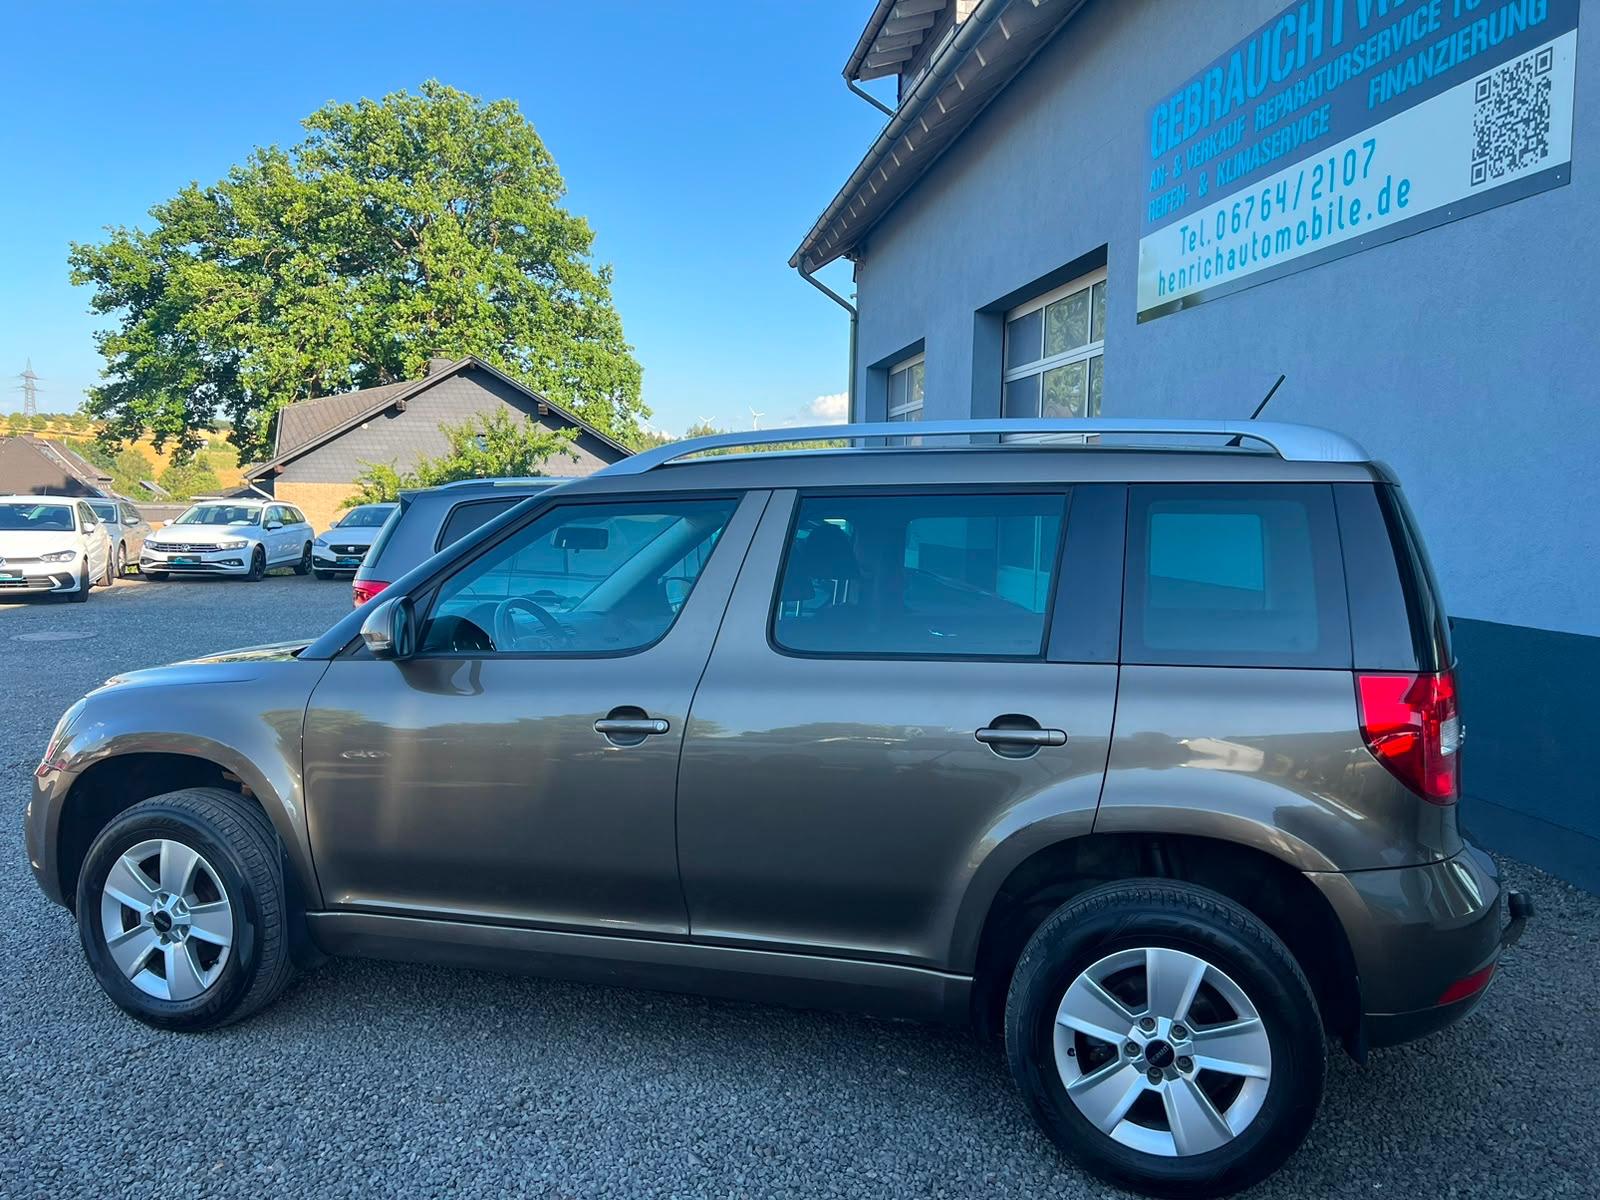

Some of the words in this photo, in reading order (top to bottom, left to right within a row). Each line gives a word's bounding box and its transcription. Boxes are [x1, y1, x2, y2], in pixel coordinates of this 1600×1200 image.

[1149, 182, 1190, 224] REIFEN-
[1198, 171, 1209, 198] &
[1216, 103, 1331, 188] KLIMASERVICE
[1368, 0, 1548, 110] FINANZIERUNG
[1150, 163, 1169, 193] AN-
[1173, 154, 1183, 180] &
[1186, 114, 1247, 171] VERKAUF
[1254, 0, 1441, 133] REPARATURSERVICE
[1152, 0, 1406, 159] GEBRAUCHT
[1158, 175, 1411, 297] henrichautomobile.de
